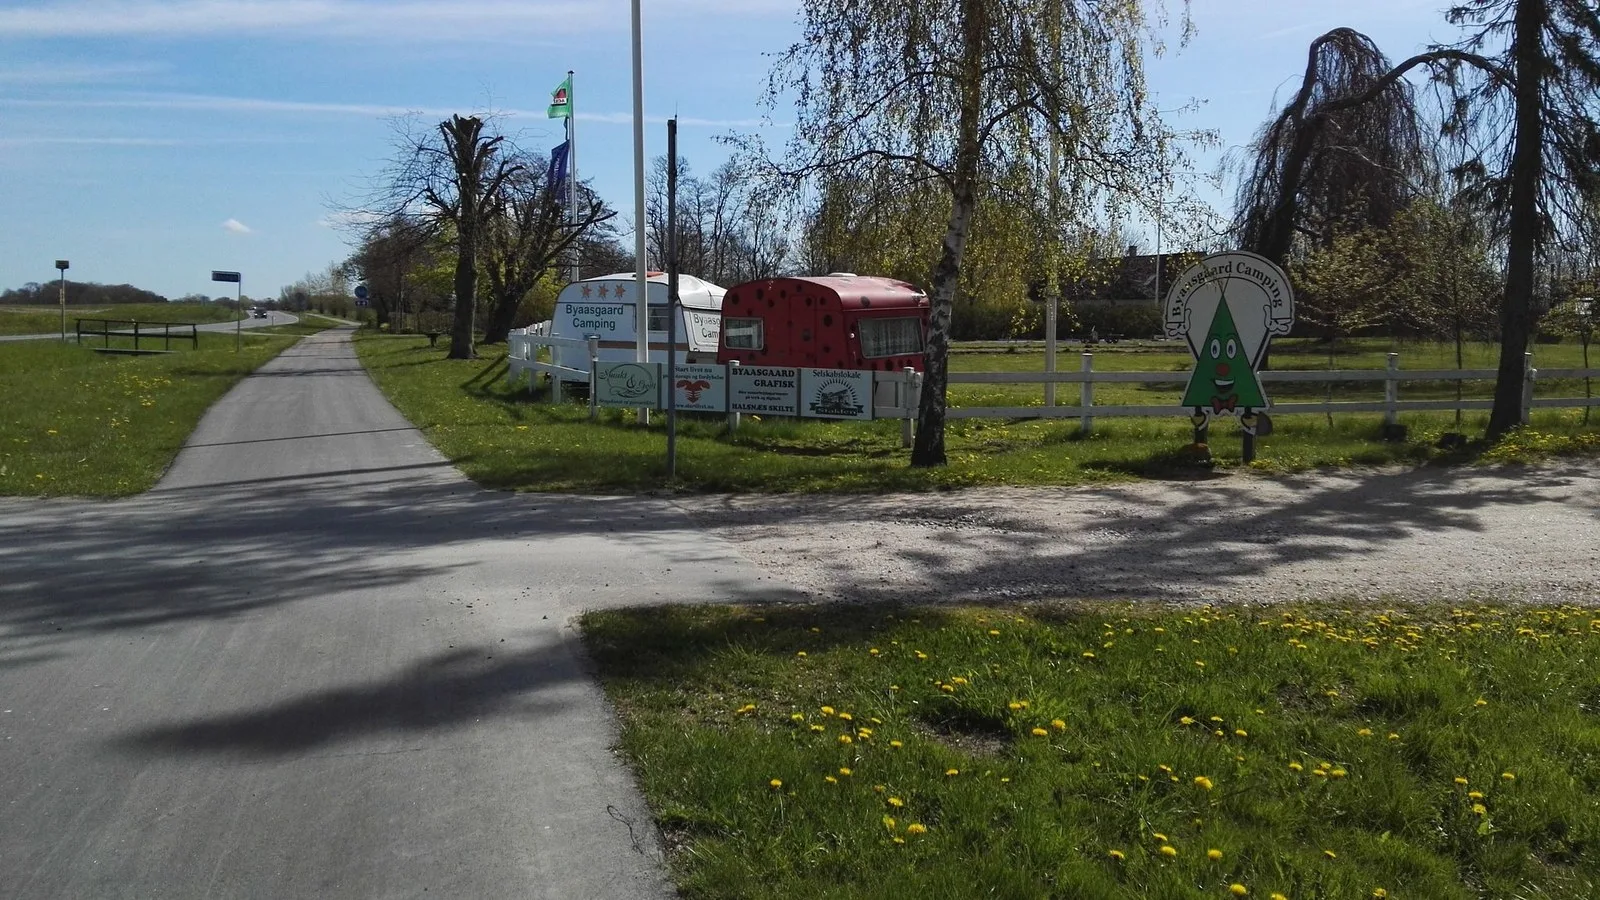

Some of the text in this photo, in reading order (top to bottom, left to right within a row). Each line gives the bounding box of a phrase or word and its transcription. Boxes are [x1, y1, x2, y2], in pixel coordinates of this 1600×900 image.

[1172, 261, 1282, 317] Byaasgaard Camping
[565, 304, 624, 317] Byaasgaard
[572, 318, 616, 331] Camping
[693, 313, 721, 327] Byaasg
[732, 368, 795, 378] BYAASGAARD
[812, 369, 861, 379] Selskabslokale
[754, 379, 795, 388] GRAFISK
[732, 403, 795, 412] HALSNÆS SKILTE
